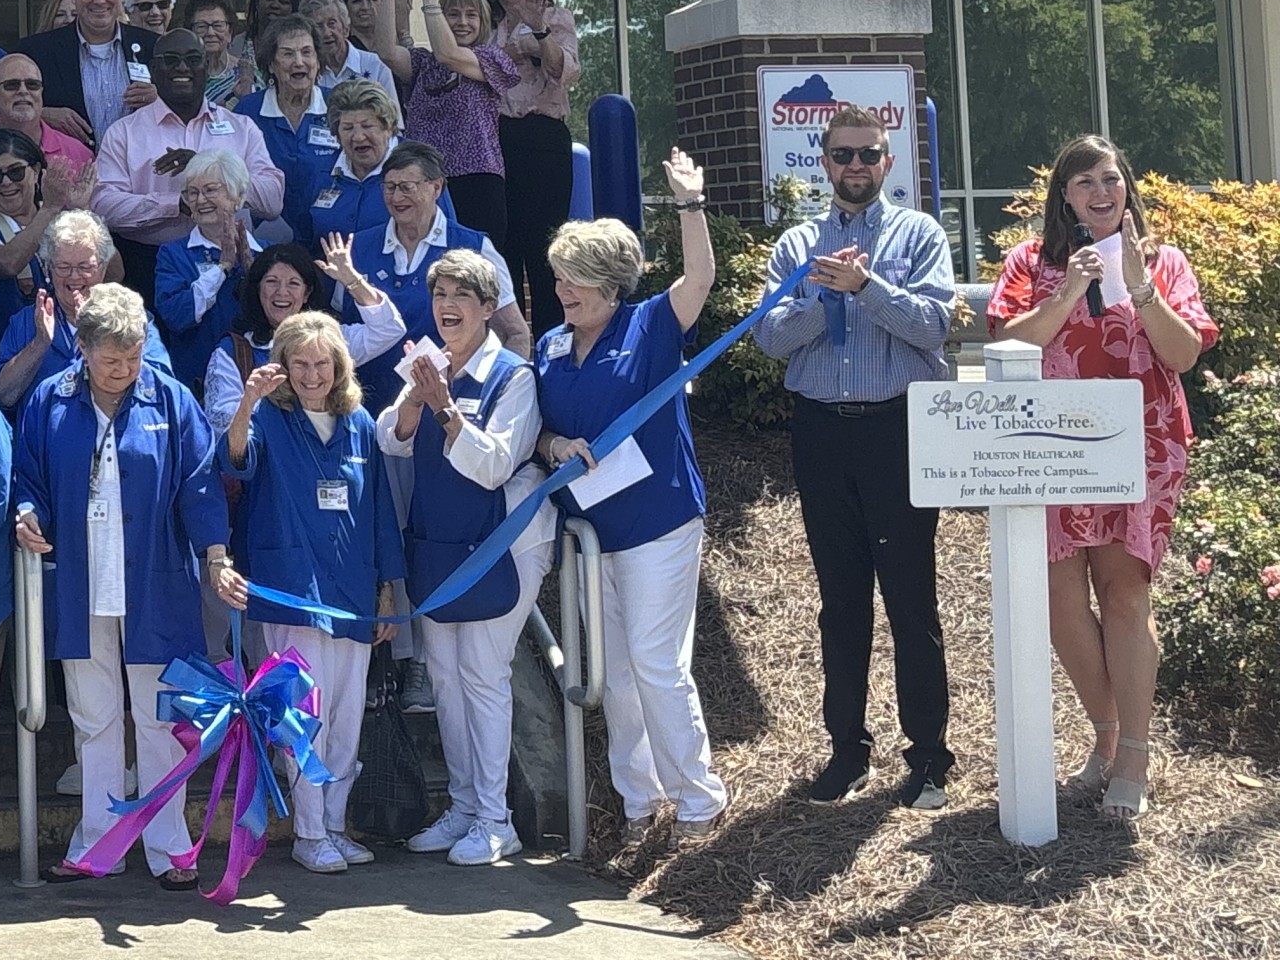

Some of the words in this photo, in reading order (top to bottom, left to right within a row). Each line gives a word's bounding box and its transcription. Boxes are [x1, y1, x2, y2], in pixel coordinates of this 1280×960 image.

[927, 389, 963, 420] Live
[955, 415, 987, 430] Live
[991, 414, 1094, 430] Tobacco-Free.
[921, 467, 946, 479] This
[949, 467, 958, 478] is
[960, 470, 967, 478] a
[969, 466, 1041, 478] Tobacco-Free
[960, 484, 976, 498] for
[979, 483, 996, 496] the
[999, 483, 1032, 495] health
[1035, 483, 1047, 497] of
[1048, 486, 1067, 495] our
[1070, 481, 1135, 496] community!
